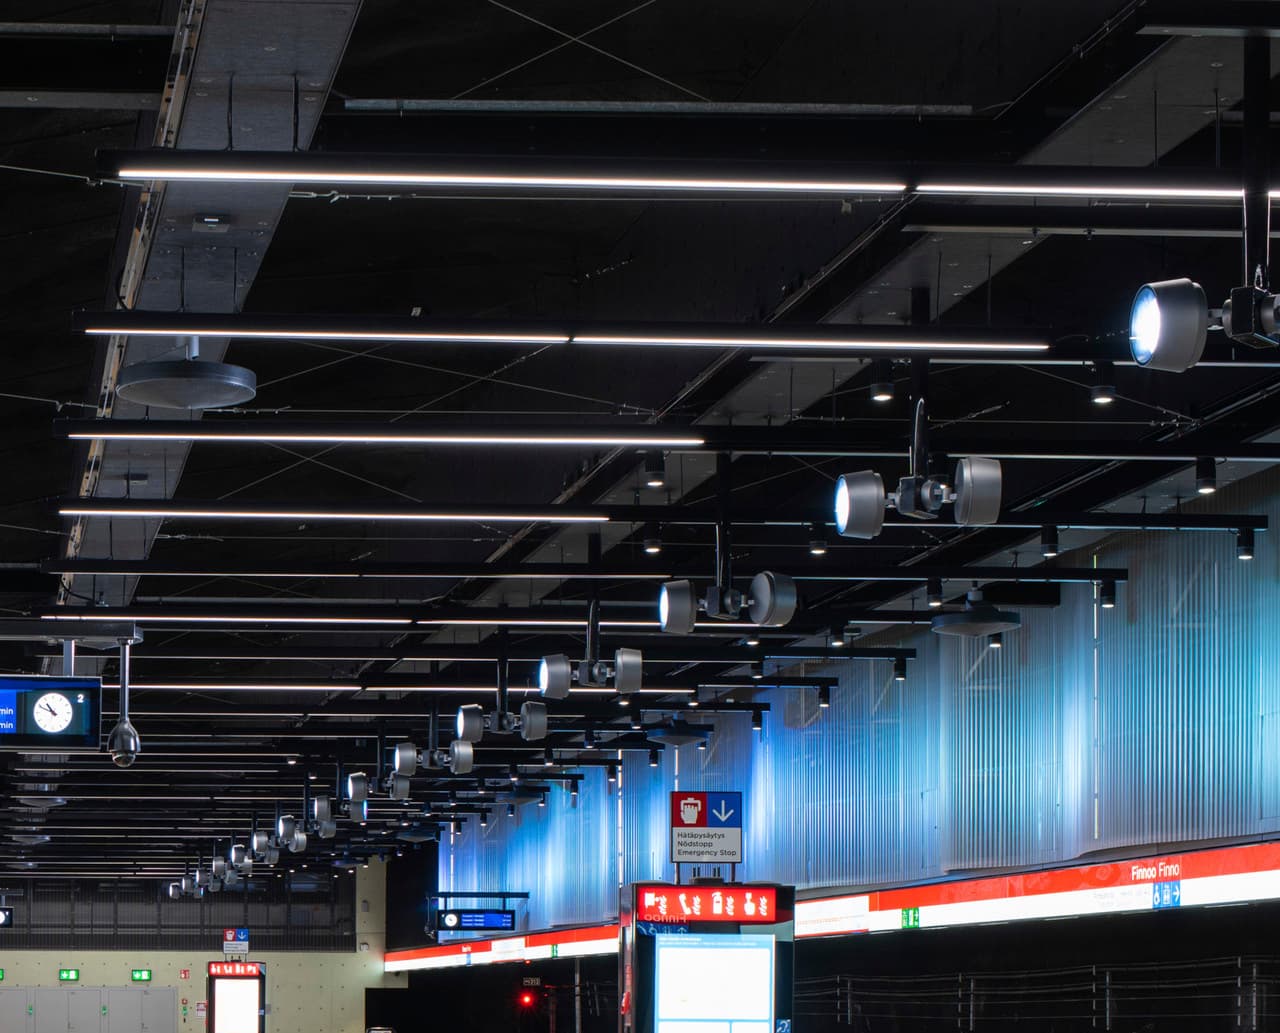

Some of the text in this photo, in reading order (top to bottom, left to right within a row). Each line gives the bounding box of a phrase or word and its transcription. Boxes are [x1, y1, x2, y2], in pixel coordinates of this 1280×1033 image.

[77, 694, 84, 703] 2
[677, 832, 725, 840] Hätäpysäytys
[677, 840, 713, 848] Nödstopp
[677, 849, 737, 857] Emergency Stop
[1131, 862, 1180, 881] Finnoo Finno
